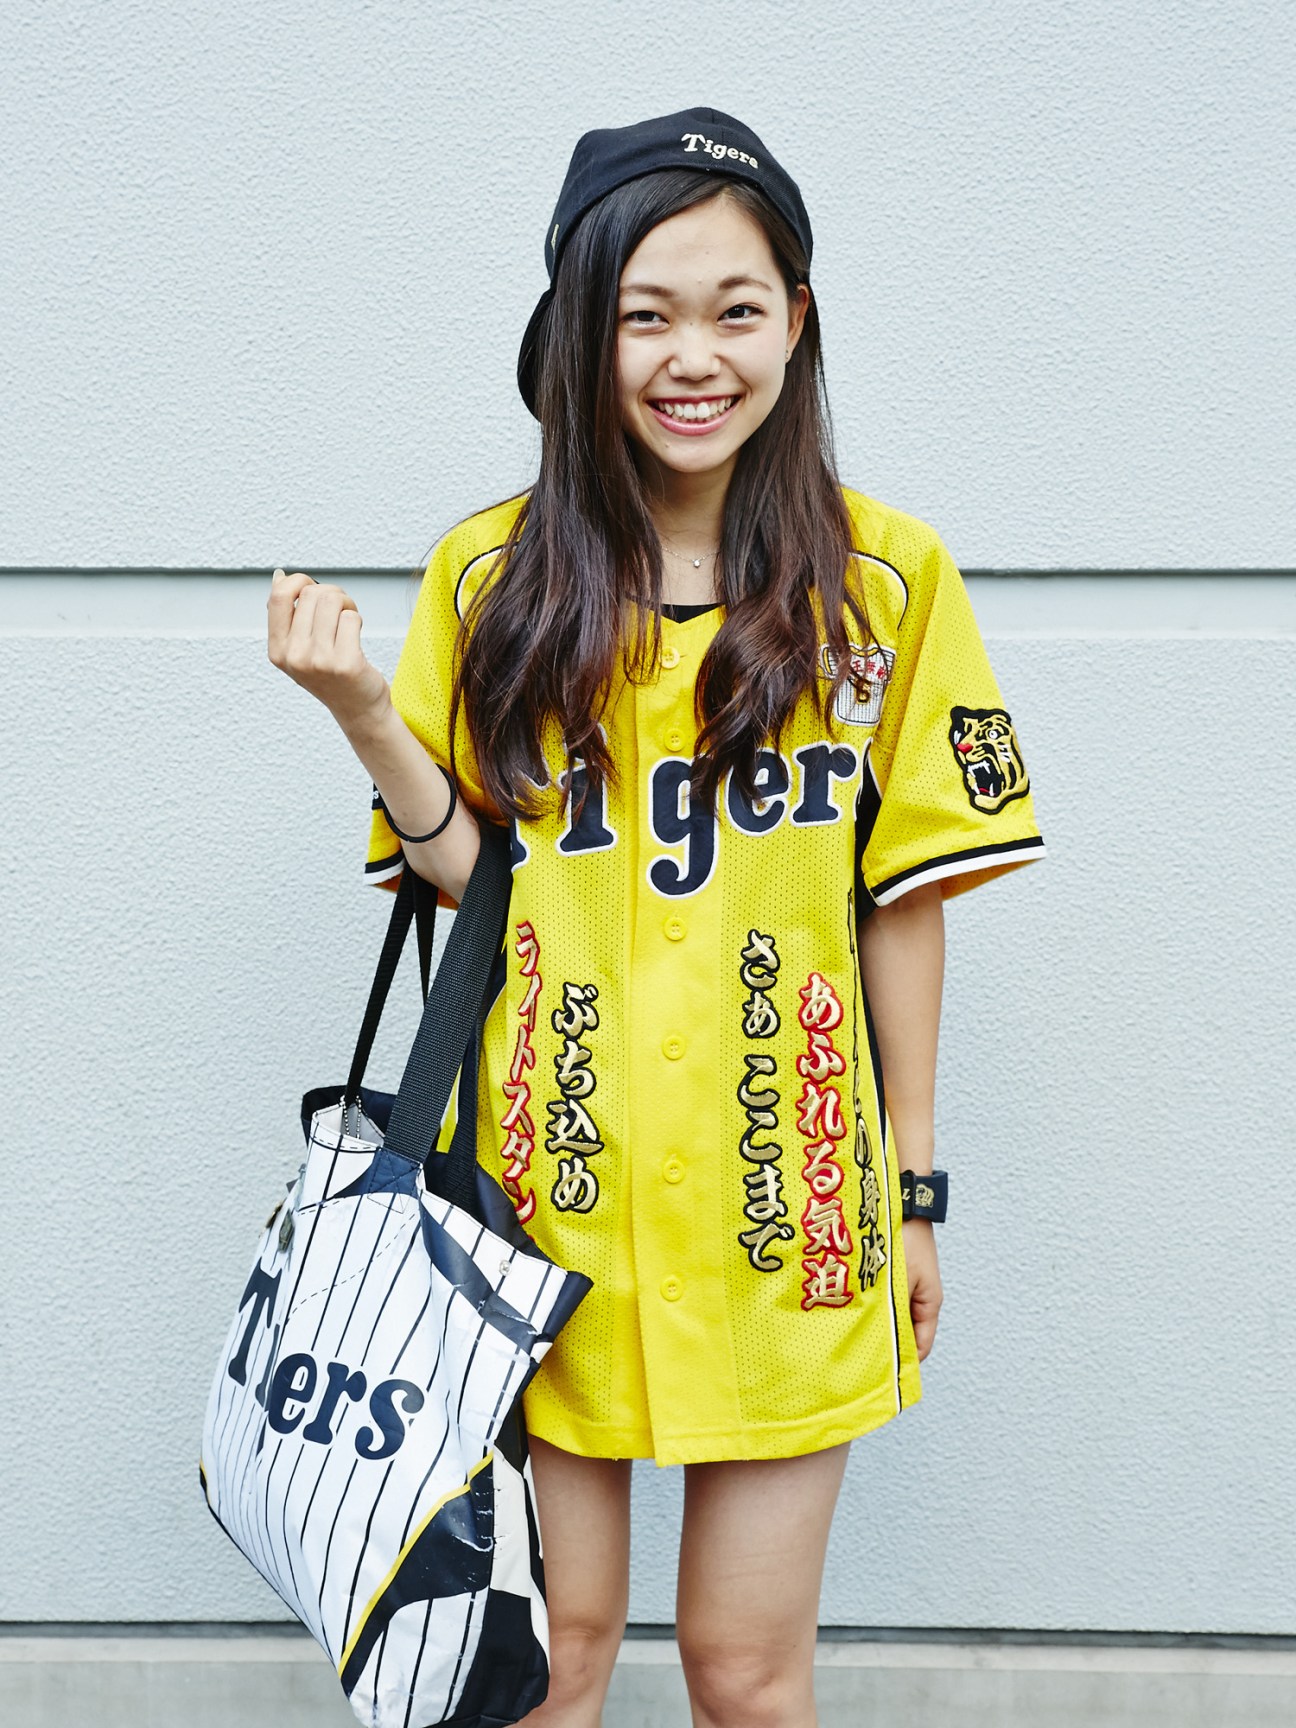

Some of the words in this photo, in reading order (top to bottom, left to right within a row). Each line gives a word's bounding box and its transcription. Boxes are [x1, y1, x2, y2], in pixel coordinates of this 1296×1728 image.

[680, 133, 759, 170] Tigers
[499, 919, 542, 1226] ライトスタン
[545, 982, 604, 1213] ぶち込め
[796, 972, 854, 1311] あふれる気迫
[228, 1256, 425, 1460] Ters
